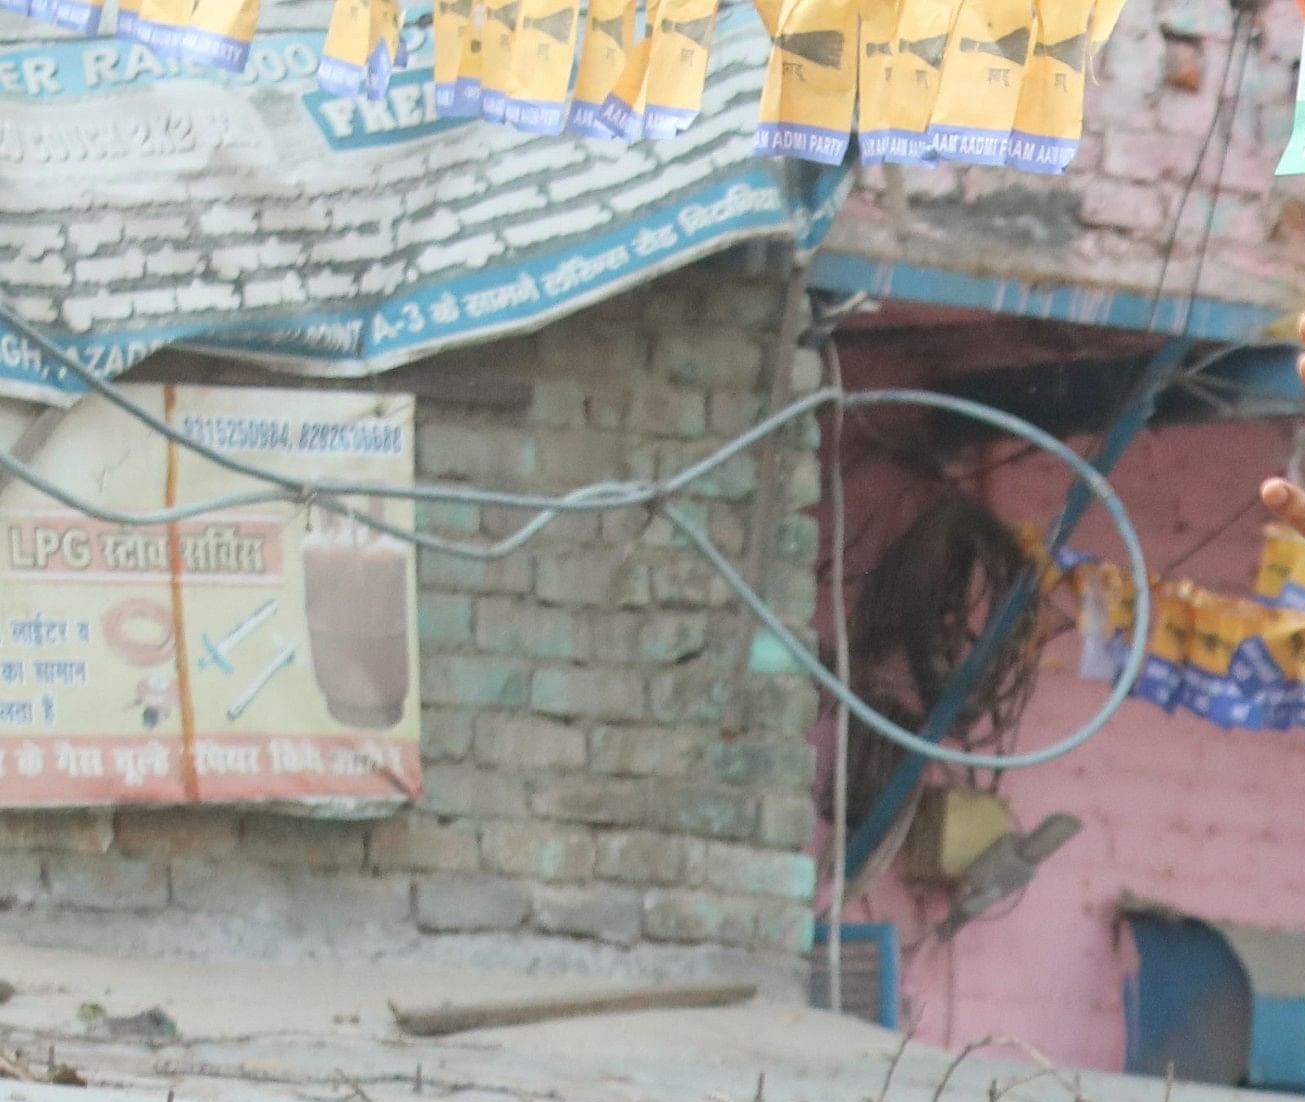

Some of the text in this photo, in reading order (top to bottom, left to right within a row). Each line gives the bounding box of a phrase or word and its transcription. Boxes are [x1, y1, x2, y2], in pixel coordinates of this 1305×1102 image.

[809, 134, 844, 157] PARTY
[931, 132, 959, 153] AAM
[9, 525, 91, 571] LPG
